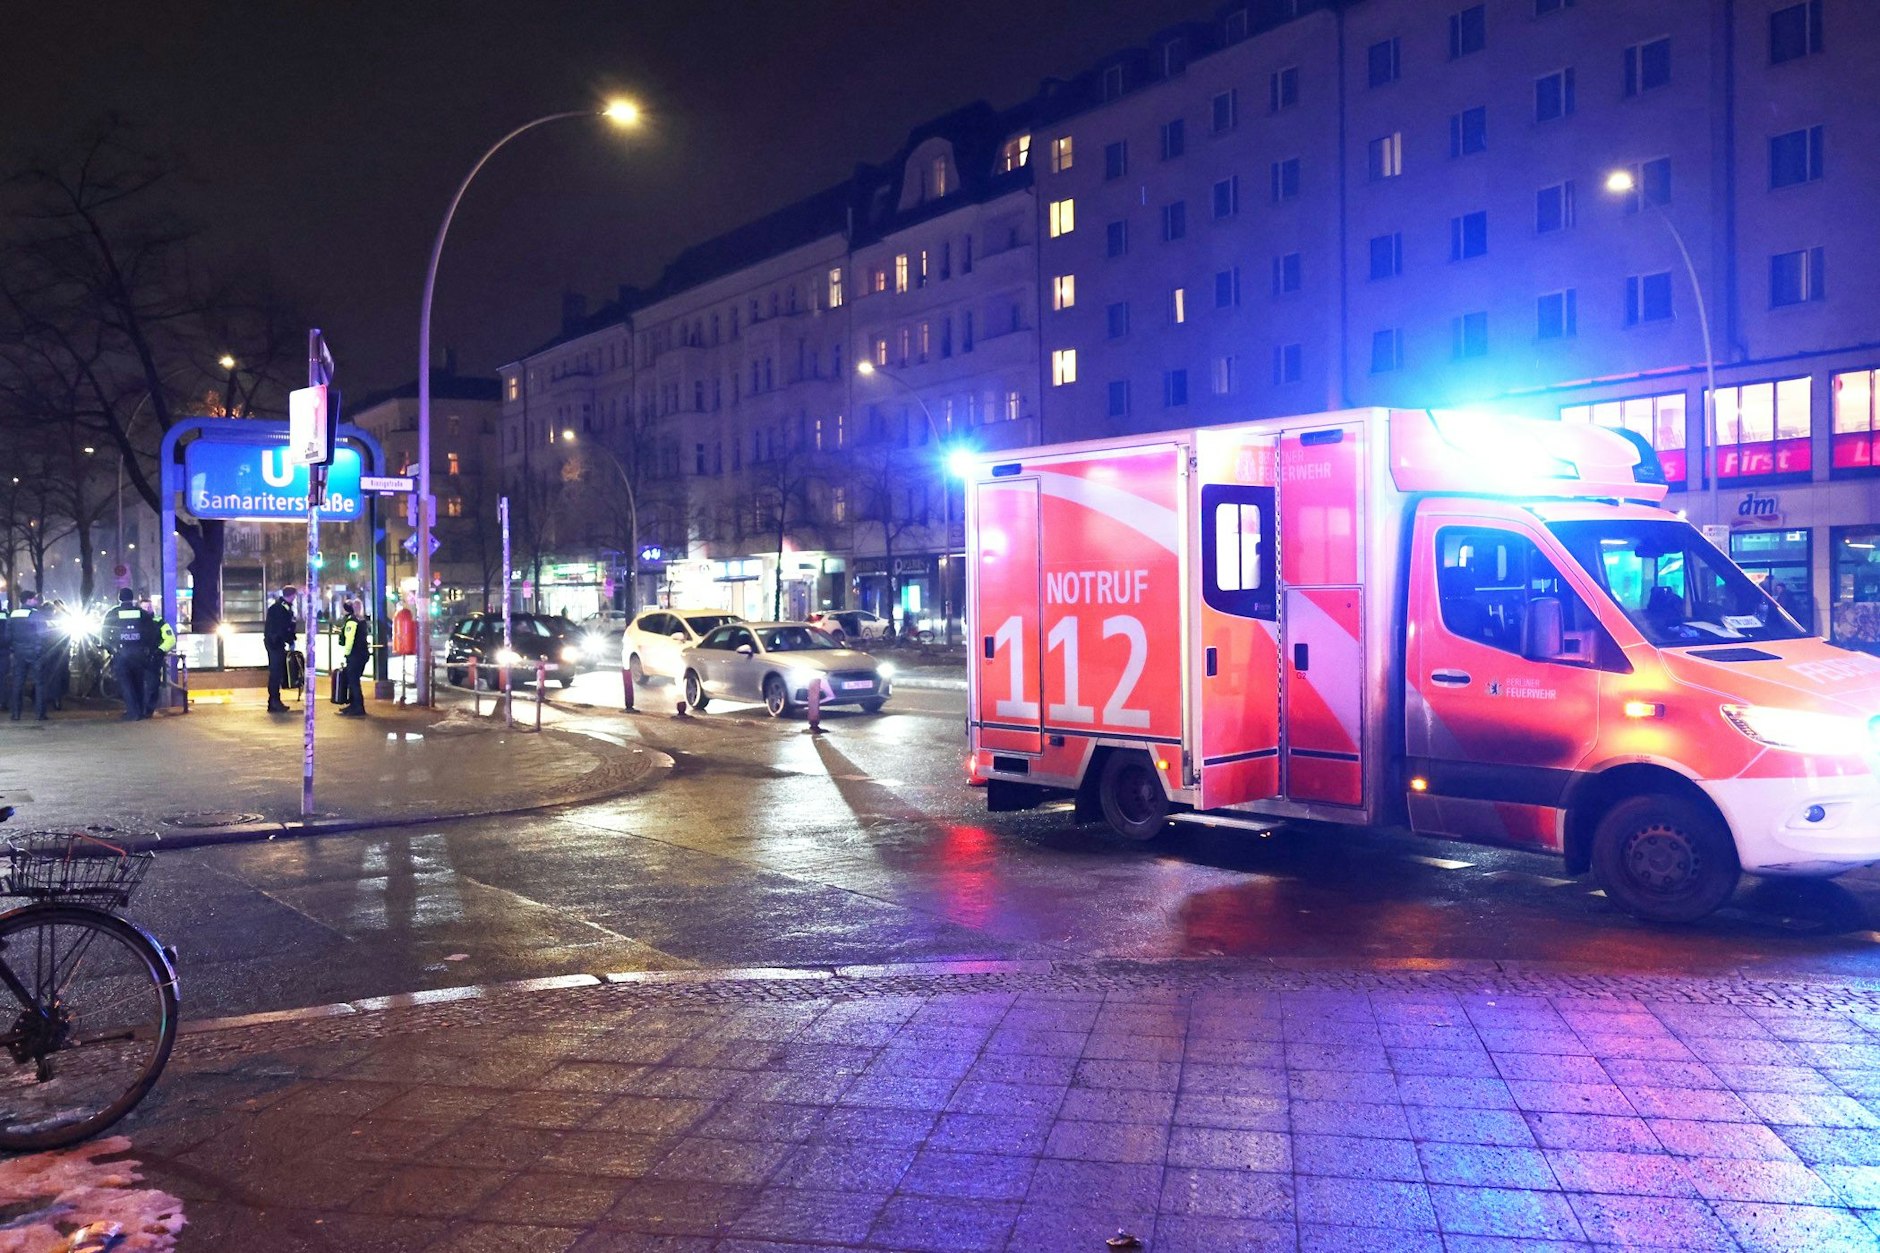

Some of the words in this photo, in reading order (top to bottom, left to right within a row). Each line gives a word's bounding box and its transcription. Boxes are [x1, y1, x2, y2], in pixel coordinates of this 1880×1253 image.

[262, 450, 294, 488] U
[1724, 449, 1791, 473] First
[200, 491, 354, 513] Samariterstaße
[1738, 494, 1775, 515] dm
[1046, 569, 1149, 605] NOTRUF
[994, 614, 1151, 729] 112
[1506, 687, 1557, 700] FEUERWEHR
